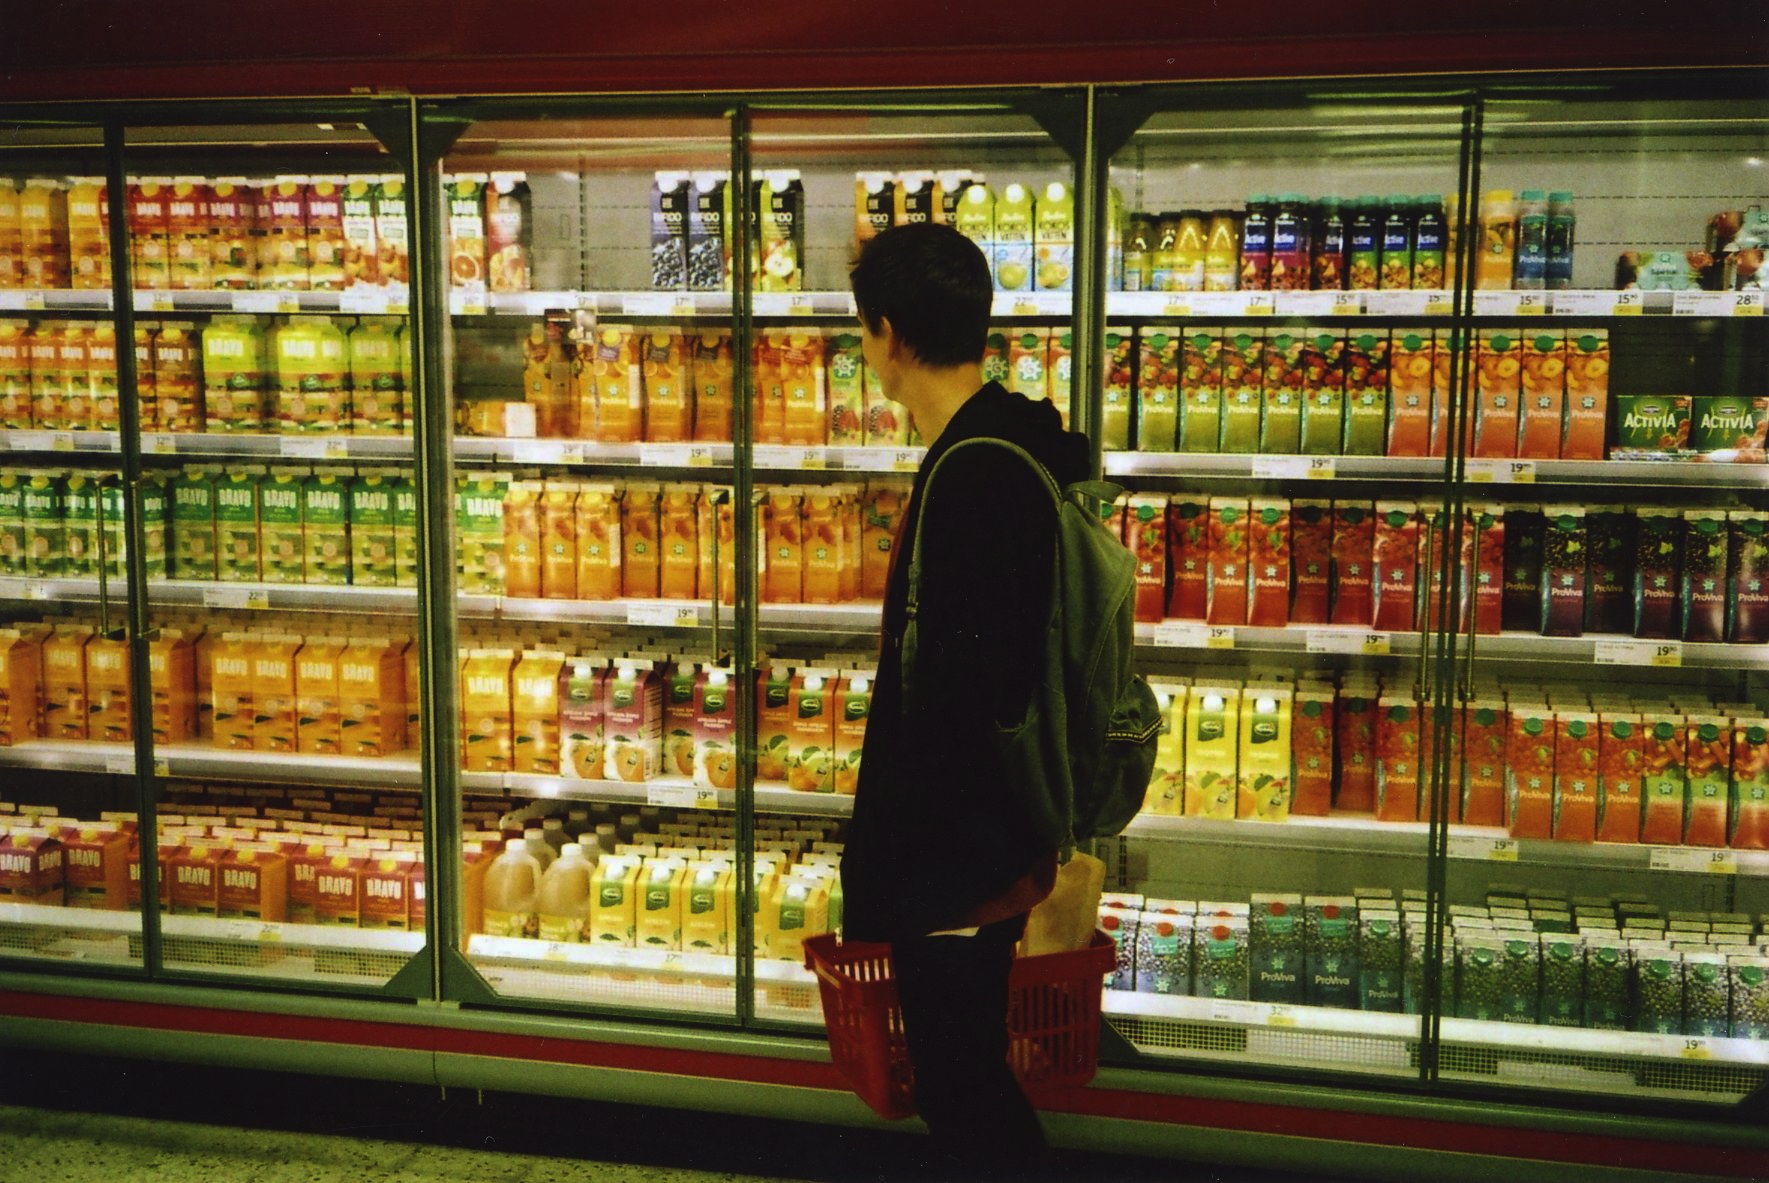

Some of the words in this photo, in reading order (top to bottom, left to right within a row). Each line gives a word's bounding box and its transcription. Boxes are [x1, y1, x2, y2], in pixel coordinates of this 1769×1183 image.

[1624, 412, 1676, 428] ACTIVIA
[1701, 414, 1754, 429] ACTIVIA
[1552, 588, 1583, 598] ProViva
[1644, 588, 1674, 599] ProViva
[1692, 592, 1724, 602] ProViva
[1738, 592, 1769, 602] ProViva
[0, 854, 31, 874] BRAVO
[68, 848, 100, 868] BRAVO
[178, 866, 210, 886] BRAVO
[224, 870, 257, 890] BRAVO
[294, 864, 315, 882] BRA
[318, 876, 352, 896] BRAVO
[366, 878, 401, 898] BRAVO
[1260, 971, 1296, 983] ProViva
[1315, 974, 1350, 986] ProViva
[1504, 1012, 1535, 1024] ProViva
